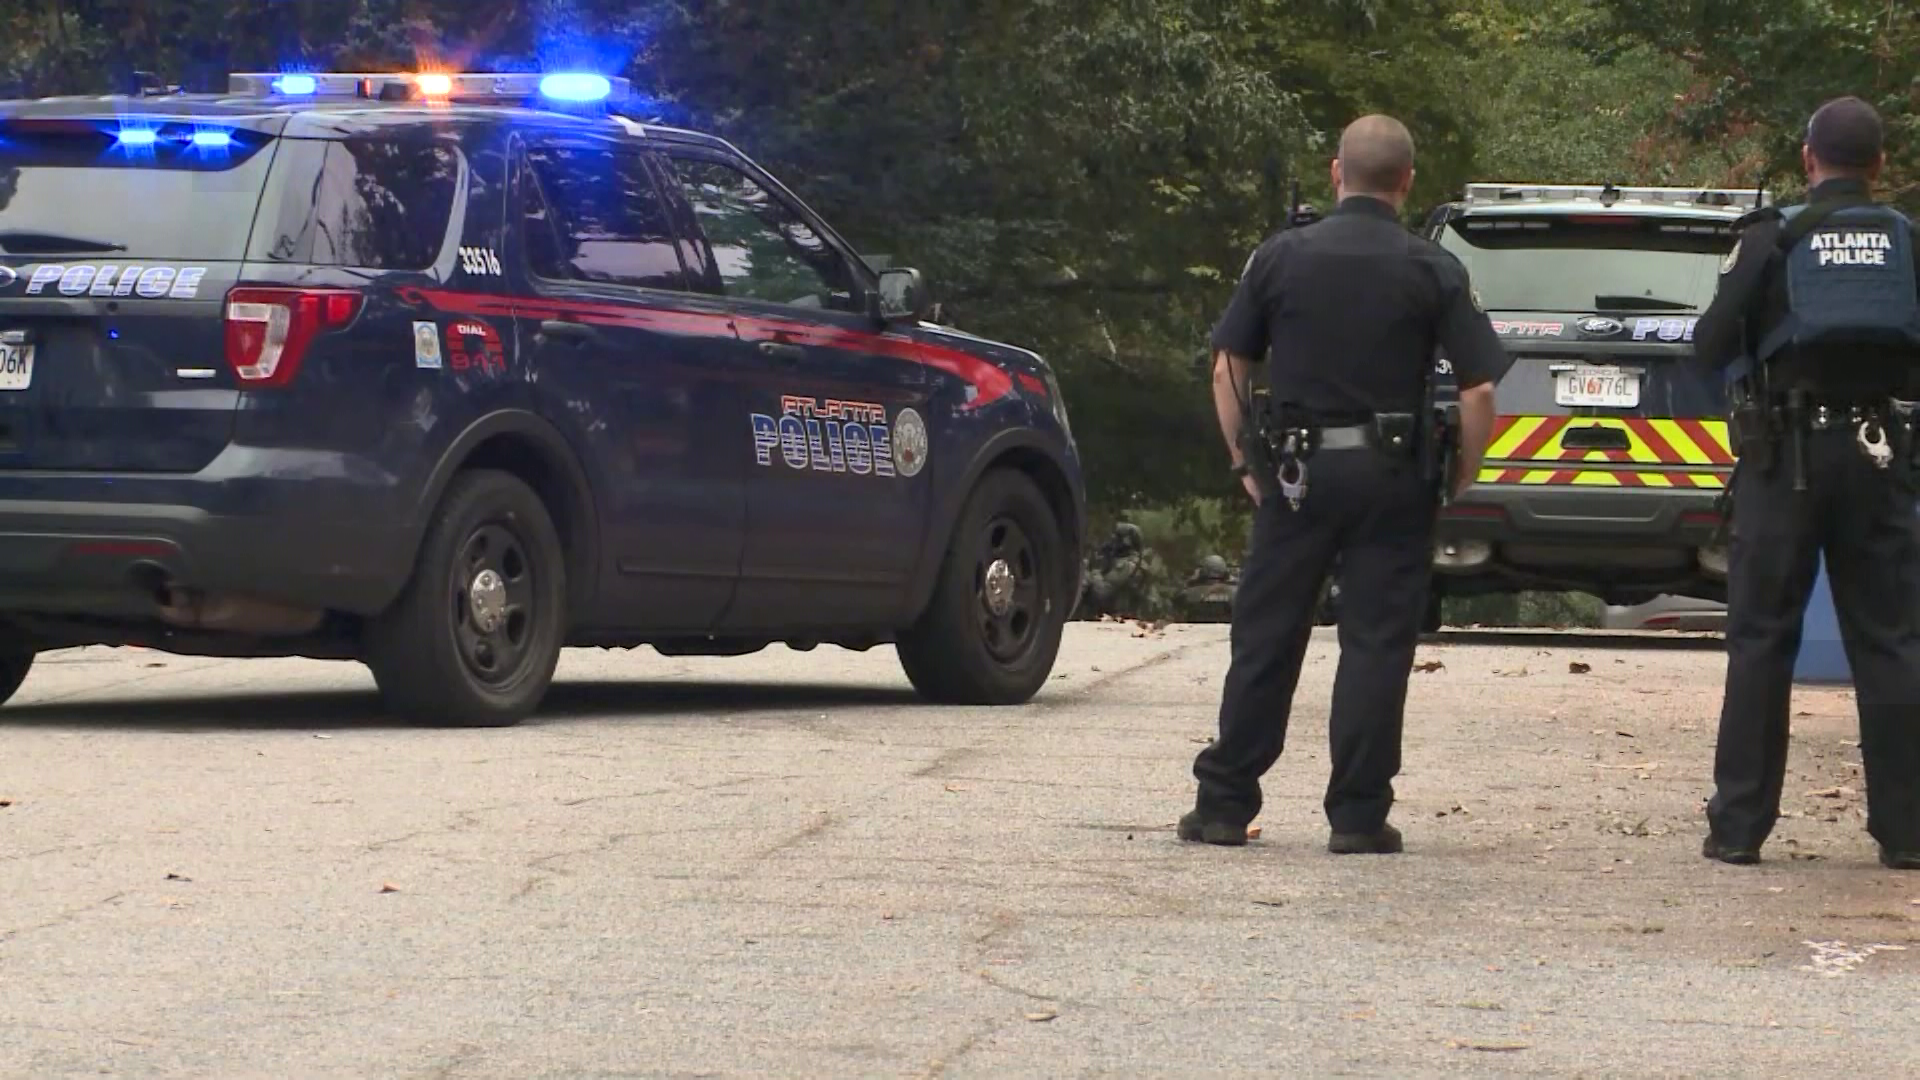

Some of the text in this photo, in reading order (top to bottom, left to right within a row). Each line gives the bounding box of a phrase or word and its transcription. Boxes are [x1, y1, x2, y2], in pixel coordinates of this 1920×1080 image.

[1810, 232, 1891, 250] ATLANTA
[458, 246, 502, 276] 33516
[1819, 249, 1886, 266] POLICE
[25, 264, 207, 299] POLICE
[457, 324, 487, 336] DIAL
[1568, 377, 1633, 396] GV6776L
[781, 394, 887, 424] ATLANTA
[751, 413, 896, 478] POLICE
